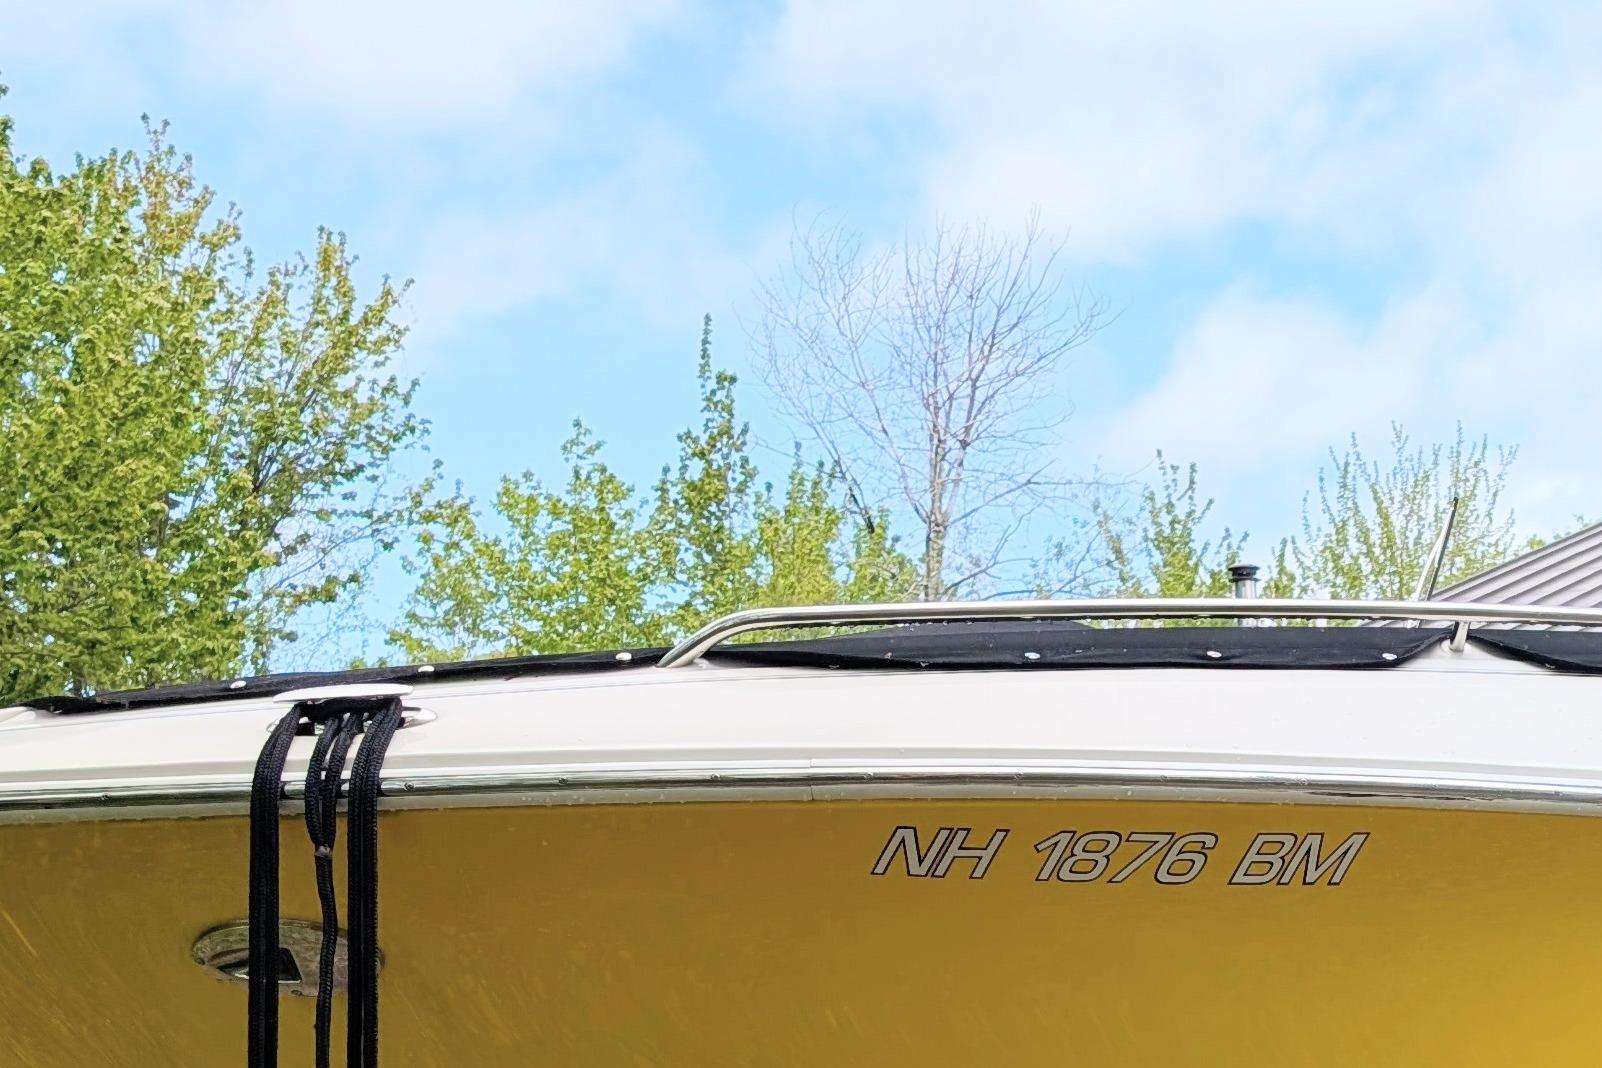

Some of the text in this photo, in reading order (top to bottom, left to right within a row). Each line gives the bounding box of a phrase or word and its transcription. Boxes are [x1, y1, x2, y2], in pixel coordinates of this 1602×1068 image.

[870, 825, 1371, 886] NH 1876 BM
